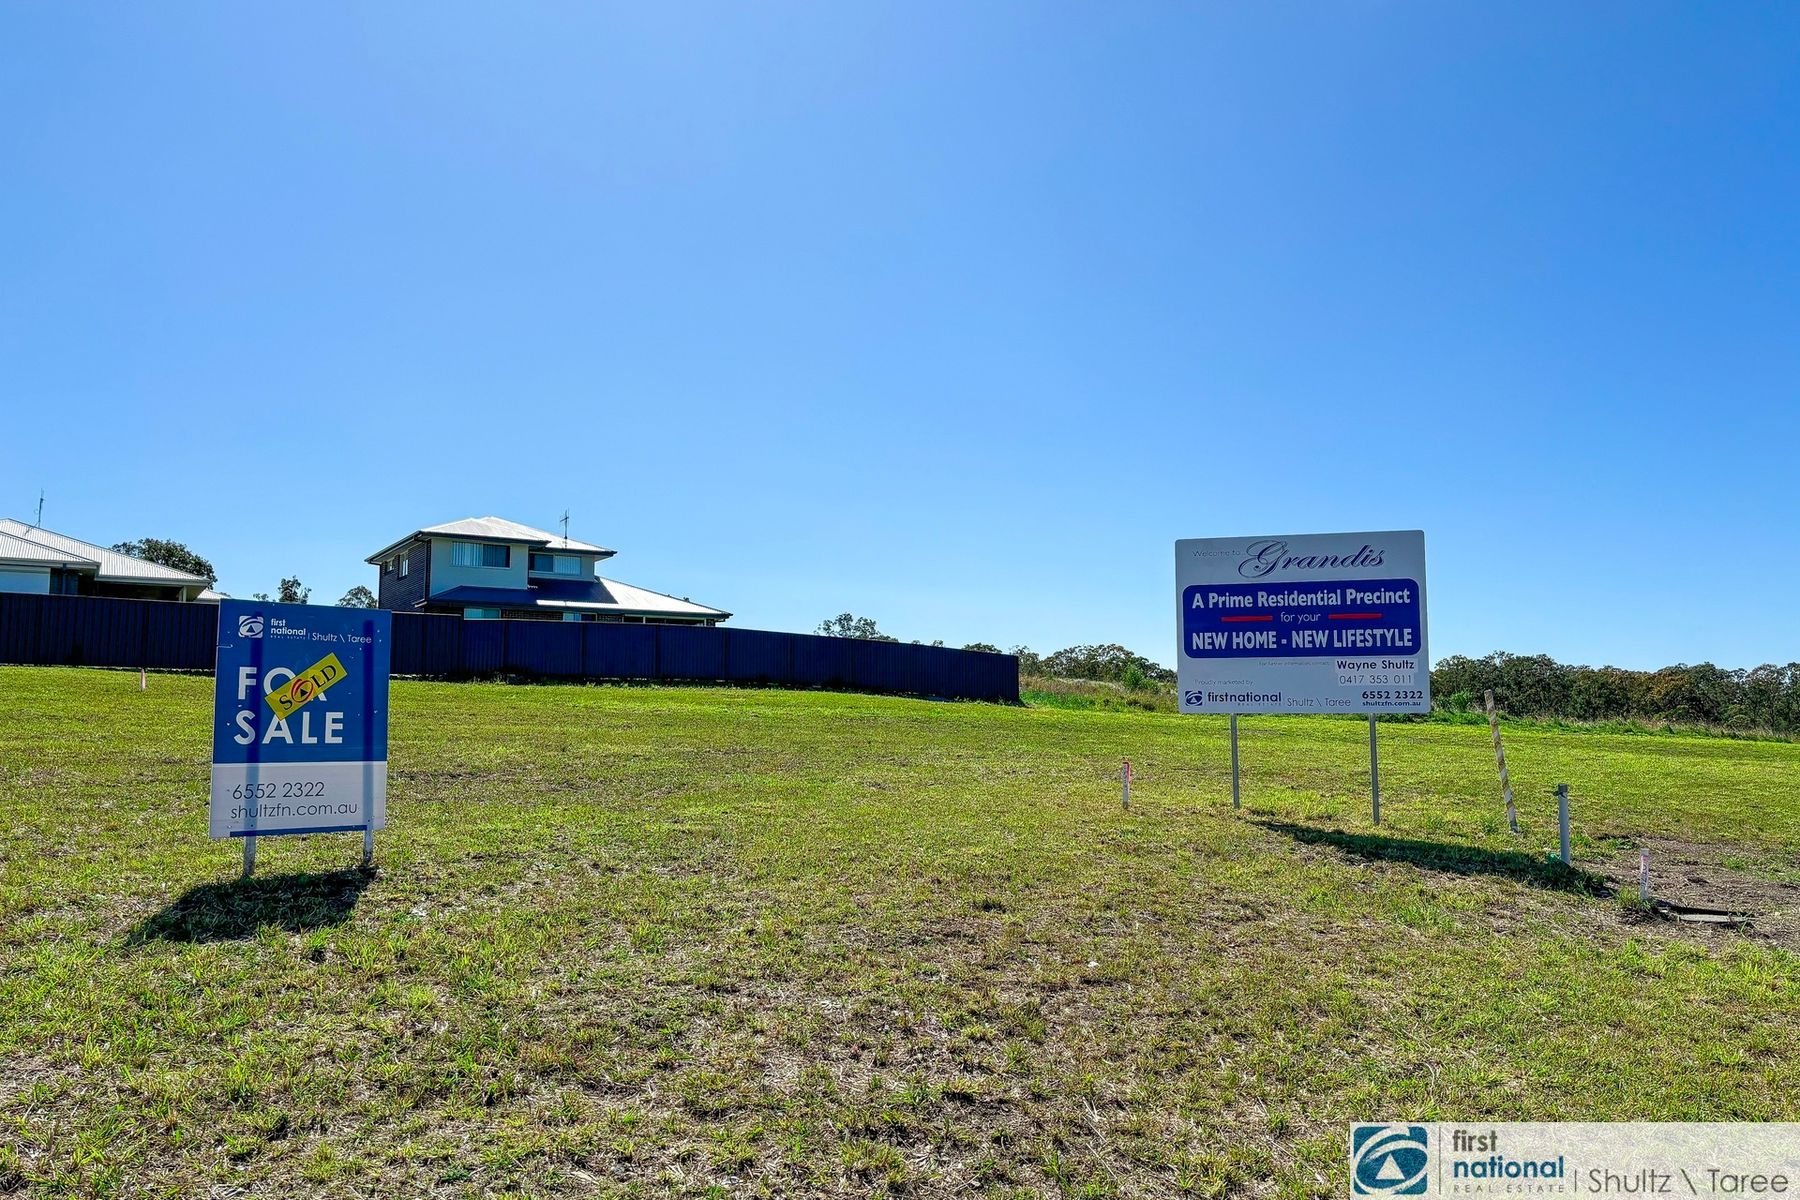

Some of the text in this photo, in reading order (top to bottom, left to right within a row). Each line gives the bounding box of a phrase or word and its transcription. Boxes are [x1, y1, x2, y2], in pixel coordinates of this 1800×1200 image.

[1238, 540, 1385, 578] Grandis
[1192, 588, 1410, 609] A Prime Residential Precinct
[271, 618, 286, 627] first
[1281, 612, 1321, 624] for your
[271, 626, 306, 636] national
[312, 632, 337, 641] Shultz
[347, 635, 372, 644] Taree
[1192, 632, 1228, 649] NEW
[1232, 631, 1277, 648] HOME
[1292, 630, 1329, 648] NEW
[1333, 629, 1412, 647] LIFESTYLE
[1337, 660, 1377, 670] Wayne
[1381, 660, 1415, 669] Shultz
[238, 667, 327, 702] FO
[1339, 675, 1412, 684] 0417 353 011
[278, 664, 337, 710] SOLD
[1287, 698, 1314, 707] Shultz
[1325, 697, 1351, 706] Taree
[1362, 691, 1423, 699] 6552 2322
[234, 710, 344, 745] SALE
[233, 782, 325, 800] 6552 2322
[231, 802, 358, 818] shultzfn.com.au
